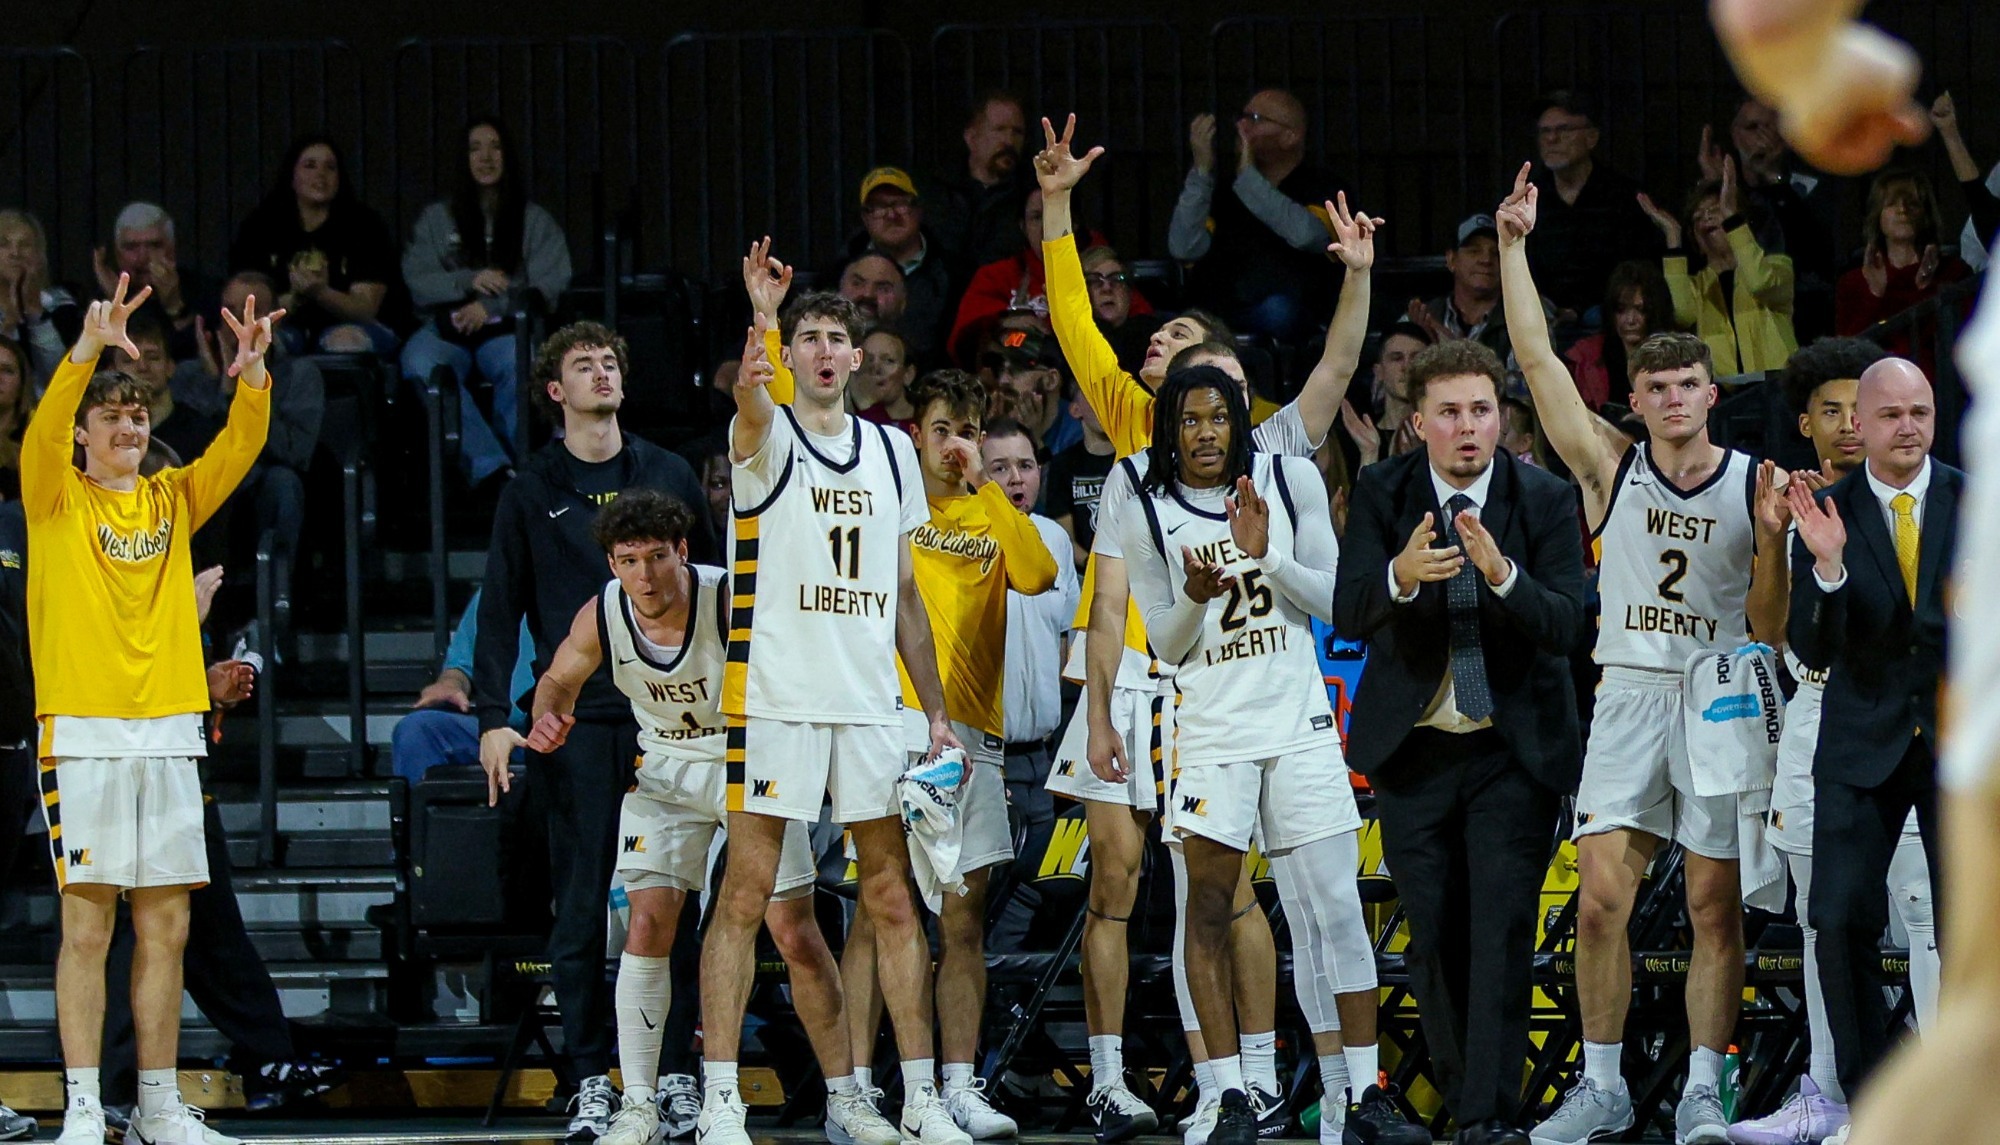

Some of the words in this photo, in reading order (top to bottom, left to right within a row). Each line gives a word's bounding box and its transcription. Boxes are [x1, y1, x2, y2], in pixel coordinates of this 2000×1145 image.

[810, 486, 873, 516] WEST
[1646, 507, 1717, 544] WEST
[828, 525, 861, 580] 11
[940, 530, 998, 574] Liberty
[1657, 547, 1689, 603] 2
[799, 583, 888, 618] LIBERTY
[1218, 567, 1273, 634] 25
[1624, 604, 1718, 642] LIBERTY
[643, 677, 709, 704] WEST
[1749, 655, 1780, 745] POWERADE
[681, 711, 702, 731] 1
[1056, 759, 1076, 778] WL
[752, 779, 780, 799] WL
[1181, 795, 1208, 817] WL
[70, 848, 93, 867] WL
[624, 836, 647, 853] WL
[515, 961, 552, 974] WEST
[1555, 960, 1575, 974] WES
